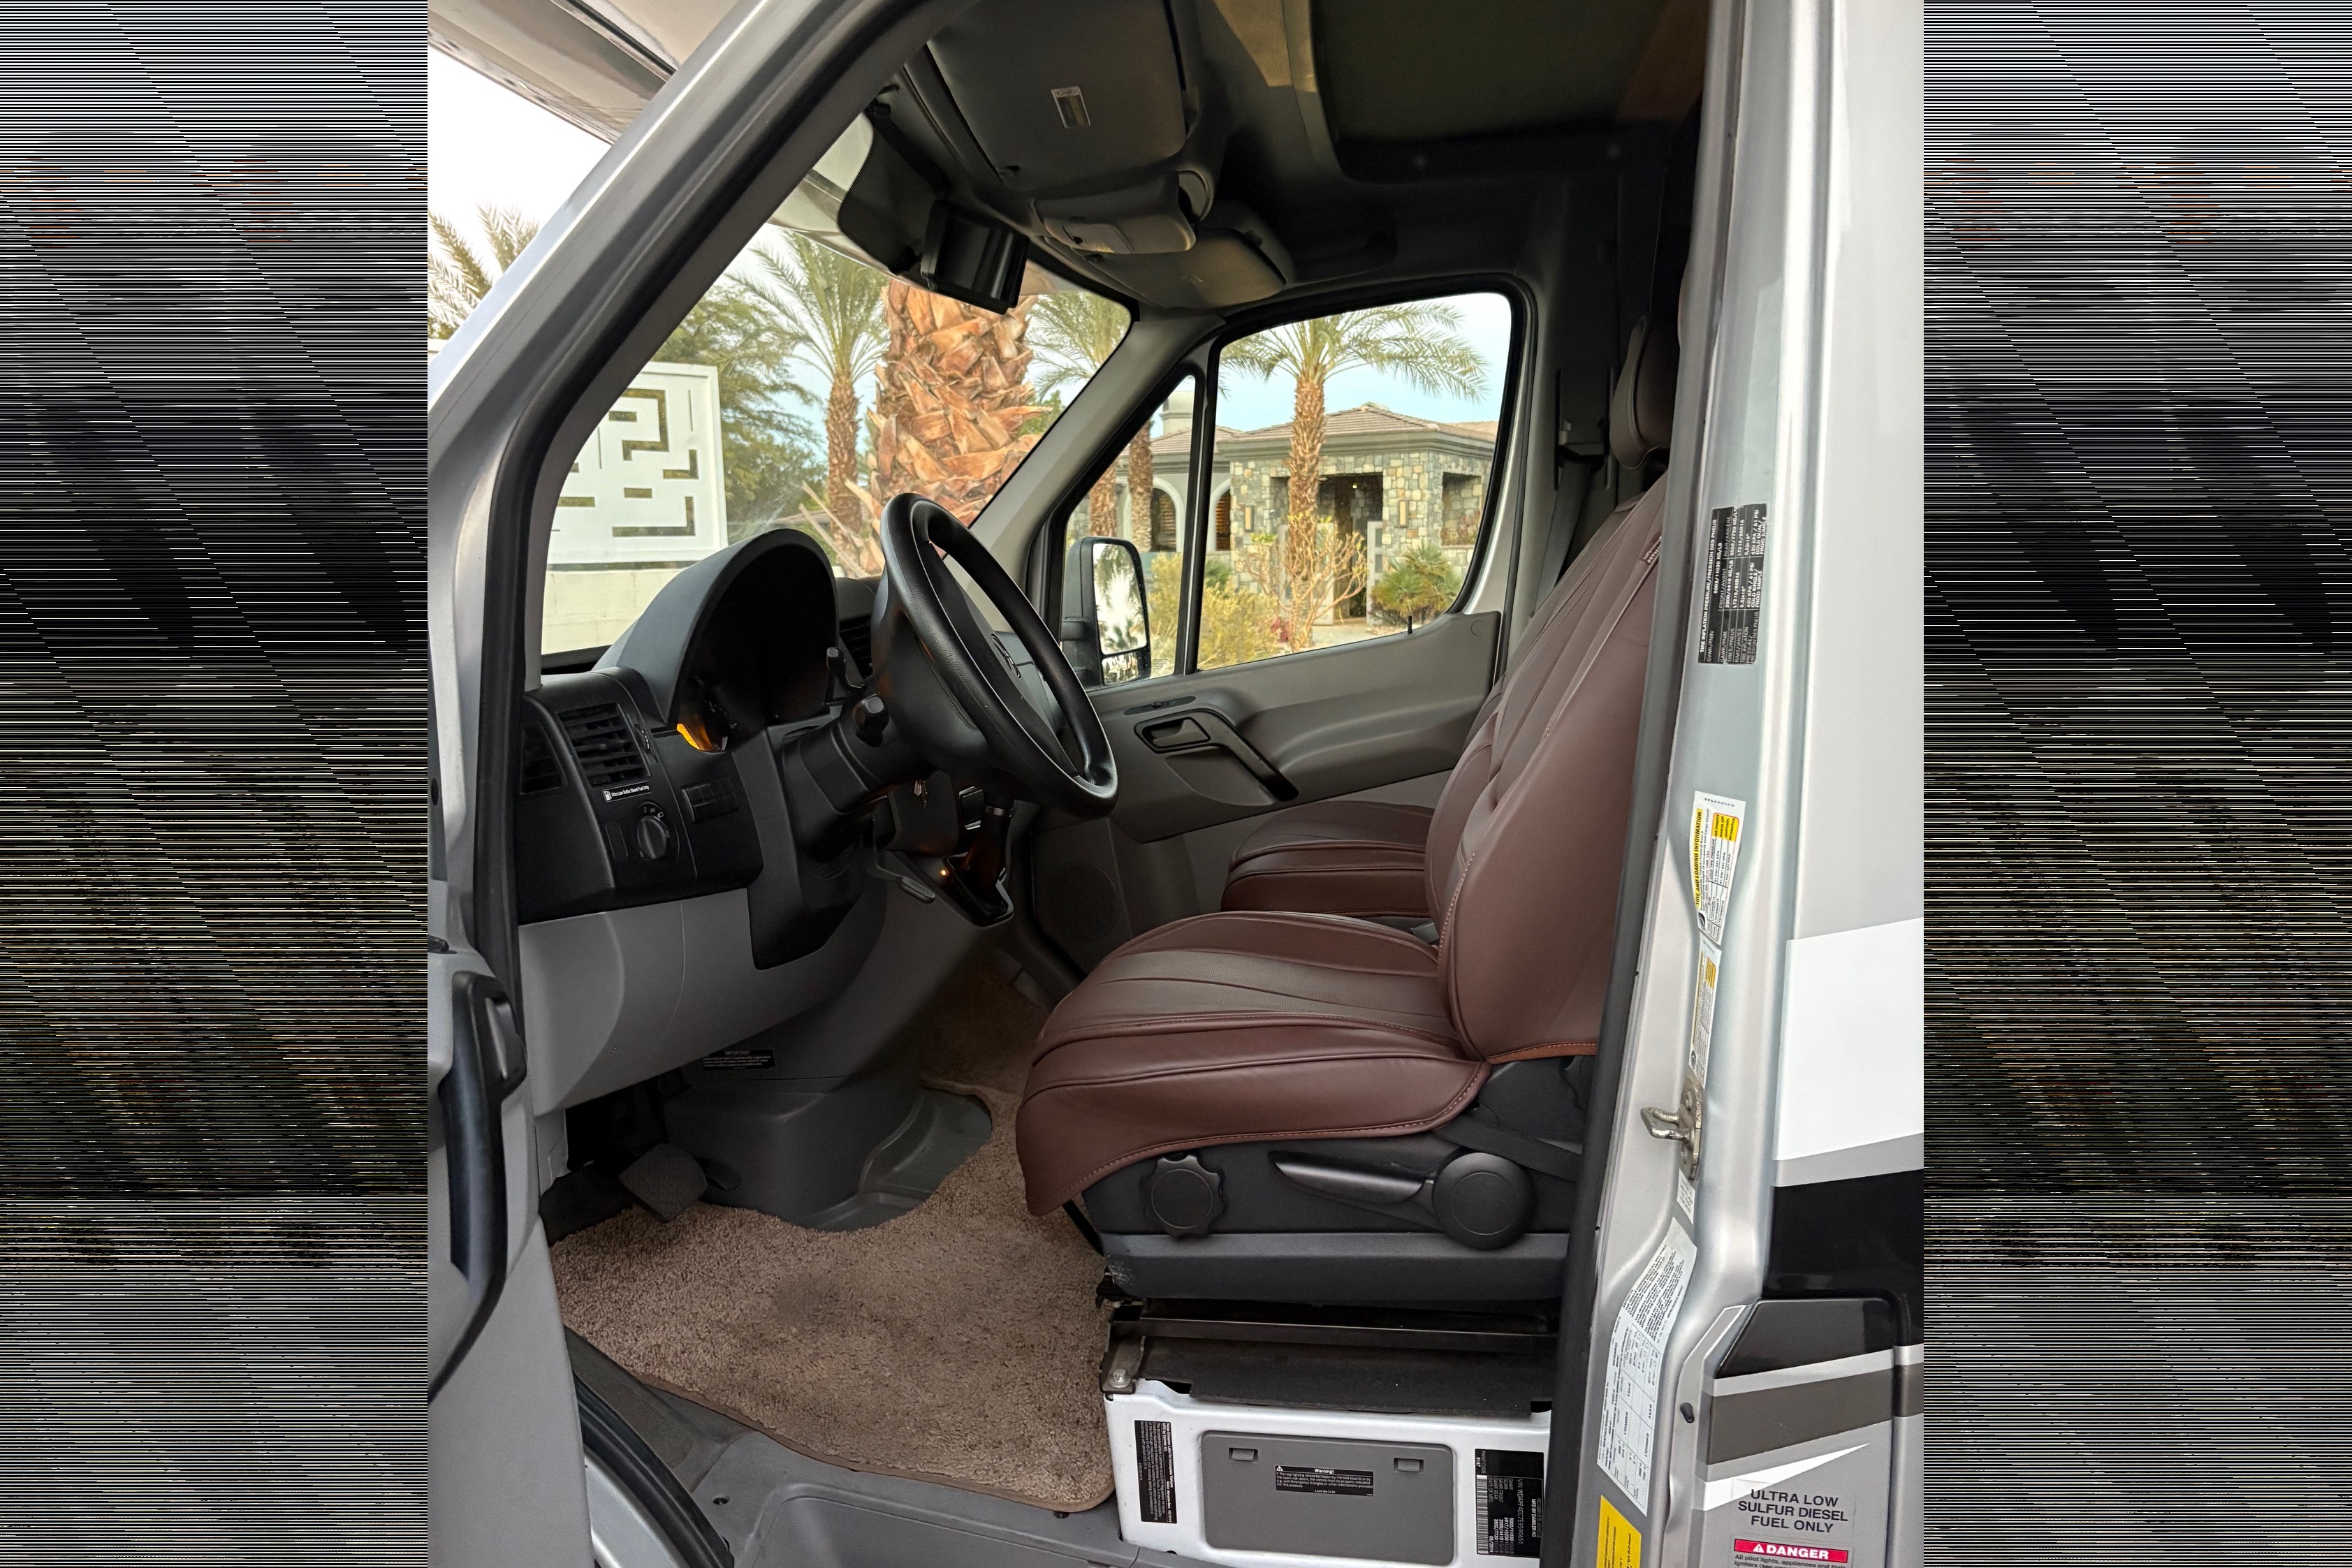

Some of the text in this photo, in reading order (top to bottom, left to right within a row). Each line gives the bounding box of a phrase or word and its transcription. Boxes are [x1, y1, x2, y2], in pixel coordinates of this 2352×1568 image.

[1751, 1489, 1839, 1507] ULTRA LOW
[1738, 1500, 1848, 1521] SULFUR DIESEL
[1751, 1516, 1834, 1533] FUEL ONLY
[1766, 1544, 1829, 1560] DANGER
